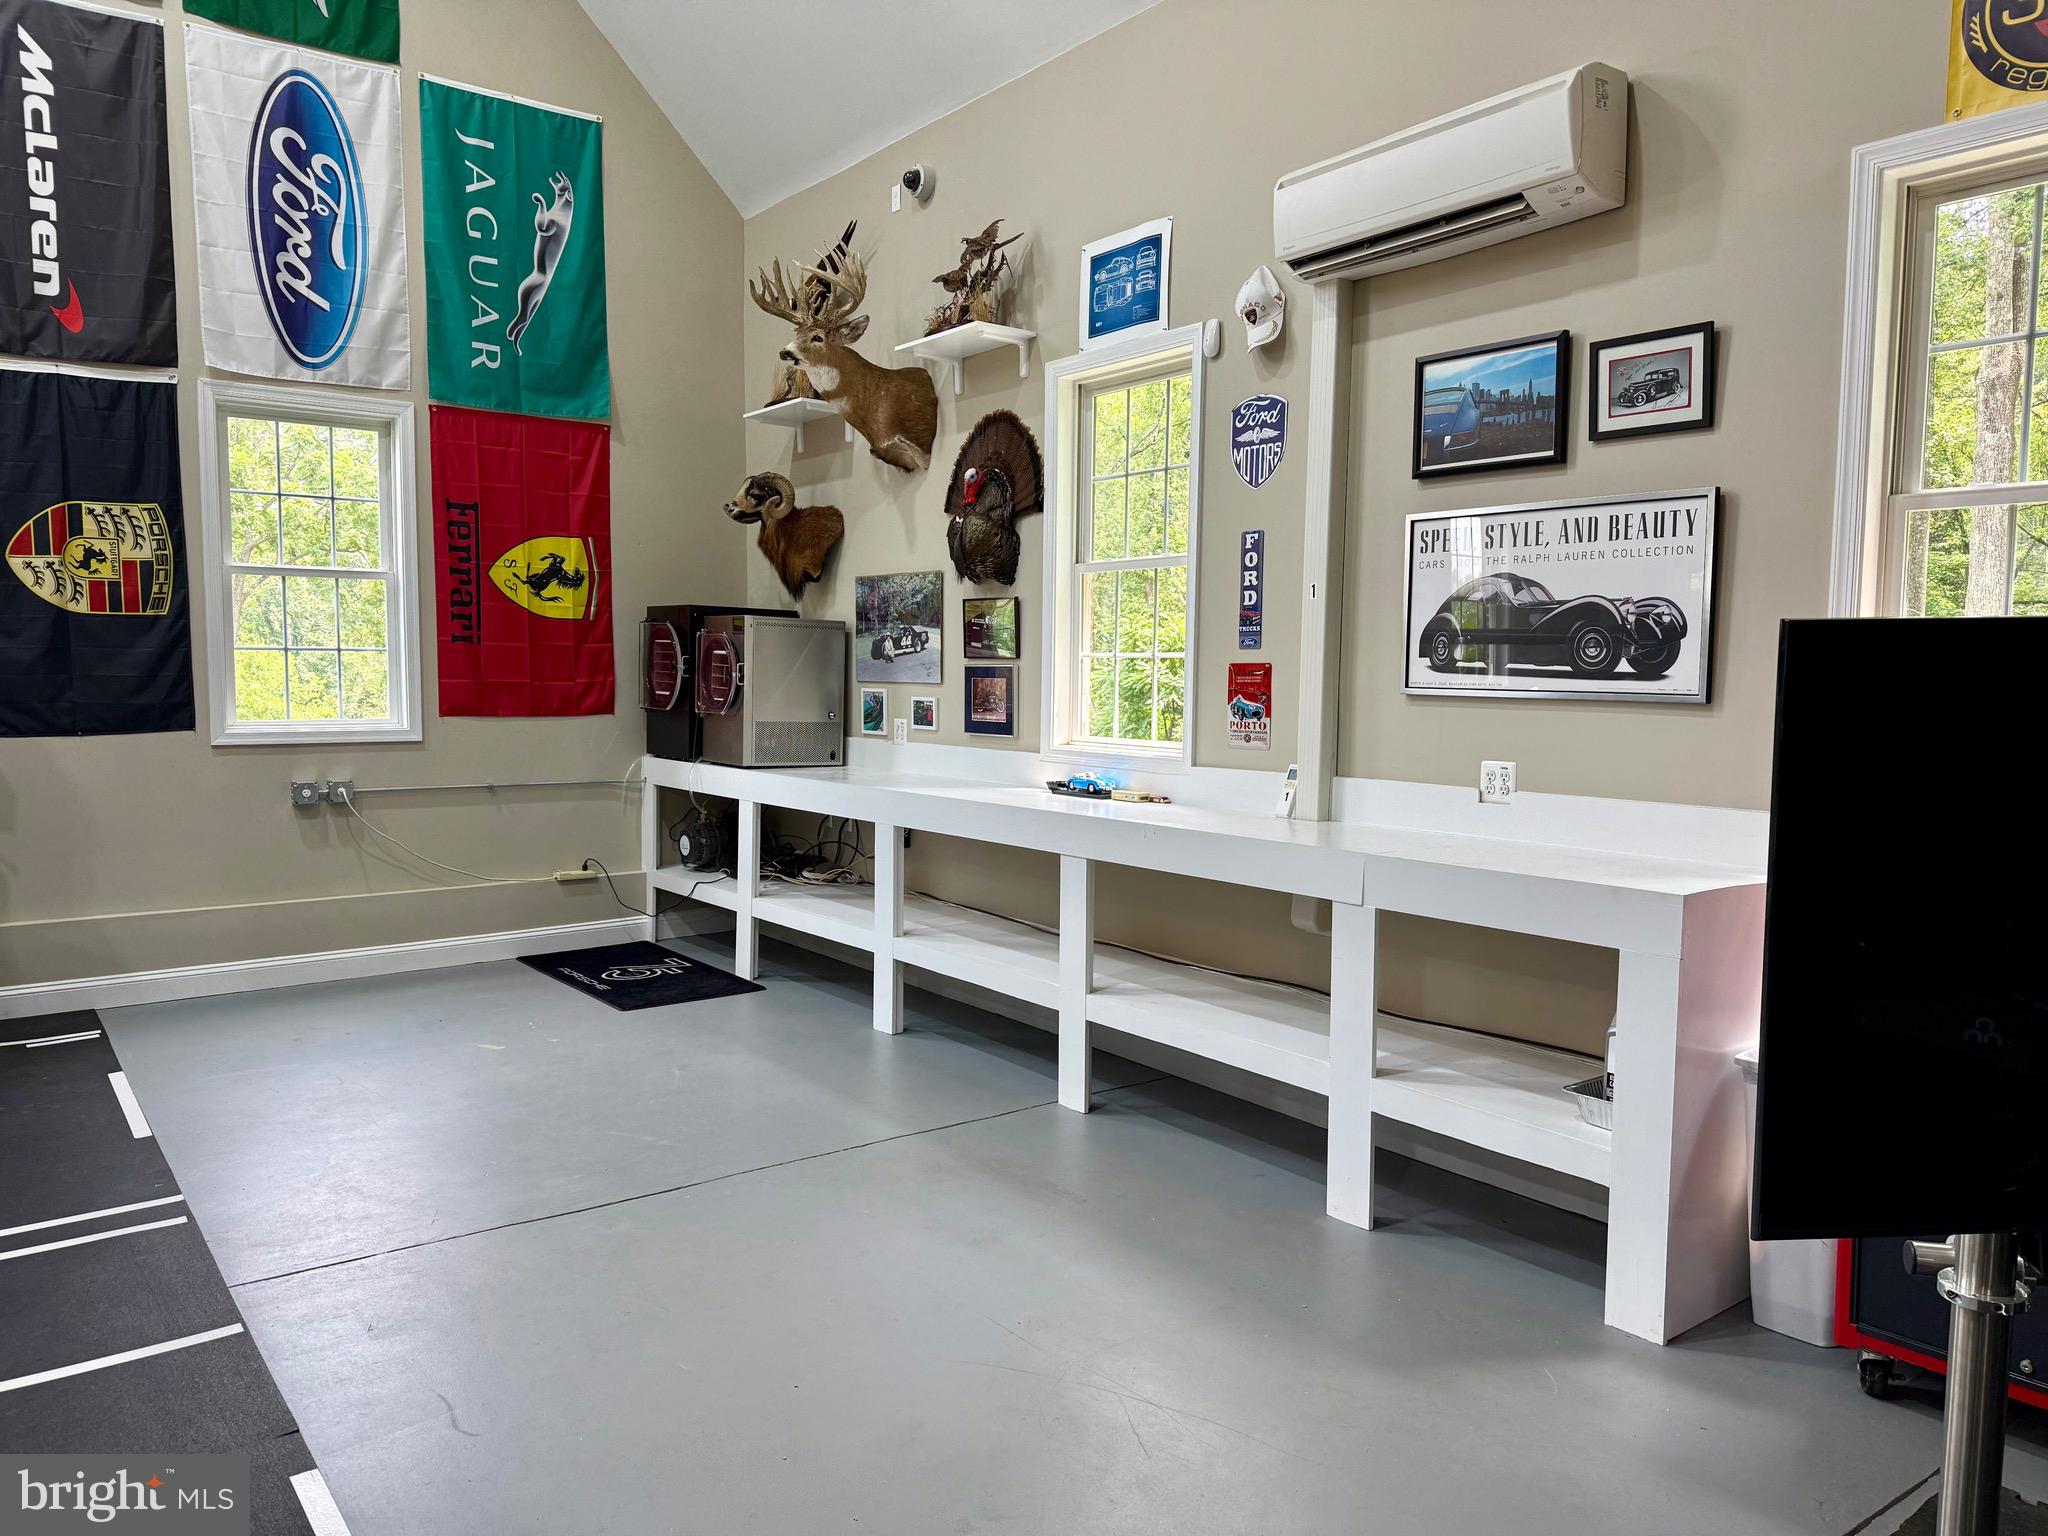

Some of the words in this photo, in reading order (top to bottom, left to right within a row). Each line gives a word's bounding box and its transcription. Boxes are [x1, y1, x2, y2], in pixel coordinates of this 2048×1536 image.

[17, 22, 60, 298] McLaren
[269, 125, 346, 313] Ford
[455, 128, 501, 370] JAGUAR
[1235, 399, 1282, 428] Ford
[1233, 442, 1282, 486] MOTORS
[1485, 520, 1549, 549] STYLE,
[1558, 516, 1599, 545] AND
[1608, 508, 1698, 541] BEAUTY
[109, 541, 119, 577] STUTTGART
[141, 506, 170, 612] PORSCHE
[446, 497, 481, 646] Ferrari
[1243, 533, 1258, 606] FORD
[1419, 560, 1445, 570] CARS
[1486, 556, 1507, 565] THE
[1513, 553, 1550, 564] RALPH
[1557, 550, 1605, 562] LAUREN
[1612, 545, 1694, 559] COLLECTION
[1311, 583, 1316, 599] 1
[1229, 721, 1267, 731] PORTO
[1284, 791, 1290, 802] 1
